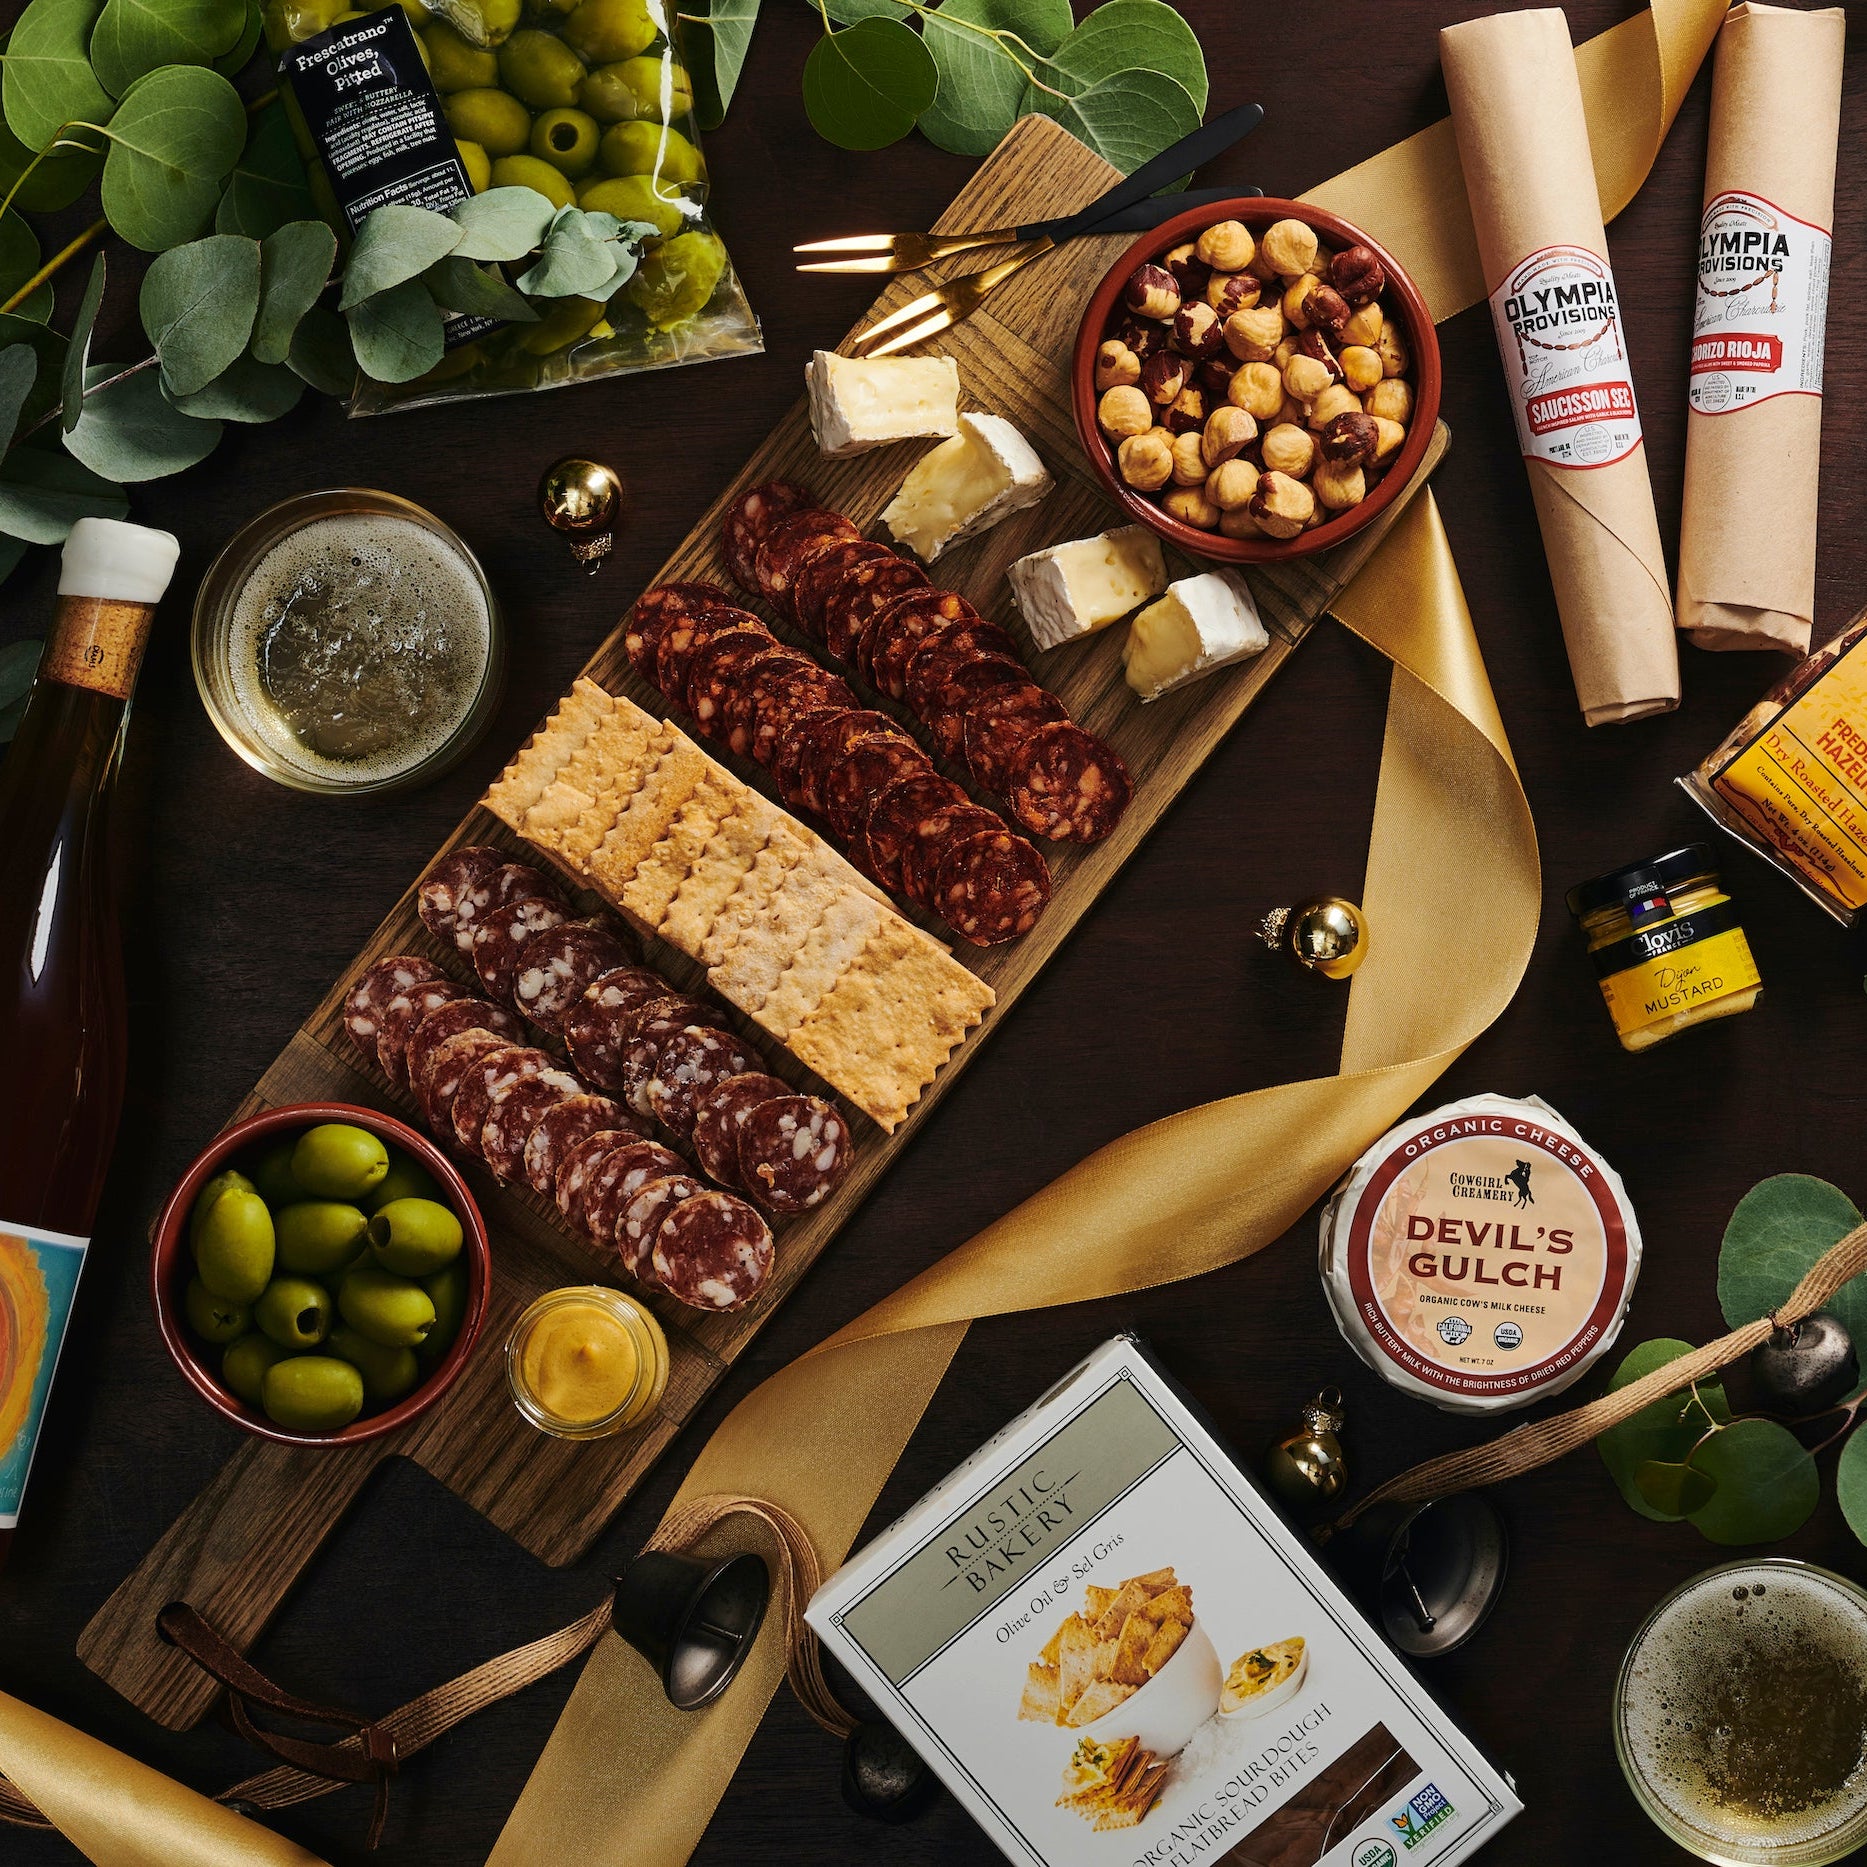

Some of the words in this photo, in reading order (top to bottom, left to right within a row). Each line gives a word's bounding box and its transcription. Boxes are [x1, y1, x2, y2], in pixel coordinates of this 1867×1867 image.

[327, 48, 379, 75] Olives,
[334, 60, 382, 91] Pitted
[343, 106, 363, 119] WITH
[365, 90, 413, 110] MOZZARELLA
[365, 86, 398, 101] BUTTERY
[325, 122, 361, 143] Ingredients:
[379, 109, 398, 119] water,
[410, 99, 426, 109] lactic
[362, 131, 377, 142] MAY
[377, 118, 408, 135] CONTAIN
[407, 111, 434, 124] PITS/PIT
[390, 111, 414, 123] ascorbic
[414, 106, 427, 115] acid
[332, 143, 371, 165] FRAGMENTS.
[370, 124, 414, 146] REFRIGERATE
[413, 119, 436, 130] AFTER
[336, 152, 366, 172] OPENING.
[365, 142, 393, 157] Produced
[403, 131, 424, 142] facility
[423, 127, 437, 135] that
[367, 155, 384, 166] eggs,
[382, 149, 396, 158] fish,
[395, 144, 411, 153] milk,
[409, 139, 423, 148] tree
[422, 135, 438, 144] nuts.
[349, 194, 385, 215] Nutrition
[384, 183, 408, 199] Facts
[430, 170, 446, 179] about
[422, 180, 444, 193] Amount
[444, 176, 454, 186] per
[423, 192, 440, 202] Total
[439, 188, 450, 197] Fat
[449, 185, 459, 194] 3g
[438, 193, 455, 204] Trans
[454, 190, 465, 199] Fat
[1700, 231, 1790, 259] LYMPIA
[1504, 281, 1615, 323] OLYMPIA
[1513, 305, 1616, 338] PROVISIONS
[1727, 340, 1771, 360] RIOJA
[1520, 362, 1581, 399] American
[1531, 389, 1611, 424] SAUCISSON
[1610, 387, 1631, 409] SEC
[1765, 732, 1790, 762] Dry
[1789, 758, 1844, 811] Roasted
[1757, 765, 1784, 795] Contains
[1783, 793, 1799, 813] Pure,
[1799, 810, 1813, 825] Dry
[1811, 823, 1838, 849] Roasted
[1835, 847, 1866, 879] Hazelnuts
[1761, 798, 1777, 815] Net
[1778, 812, 1790, 830] Wt.
[1791, 828, 1800, 836] 4
[1797, 835, 1809, 848] oz.
[1809, 846, 1837, 872] (114g)
[1628, 880, 1656, 894] PRODUCT
[1629, 892, 1636, 900] OF
[1635, 885, 1660, 898] FRANCE
[1652, 941, 1684, 957] FRANCE
[1654, 964, 1701, 991] Dijon
[1645, 976, 1724, 1016] MUSTARD
[1404, 1119, 1503, 1157] ORGANIC
[1514, 1124, 1594, 1179] CHEESE
[1452, 1185, 1515, 1202] CREAMERY
[1406, 1215, 1575, 1255] DEVIL’S
[1408, 1252, 1562, 1291] GULCH
[1419, 1294, 1459, 1306] ORGANIC
[1460, 1298, 1489, 1309] COW'S
[1490, 1301, 1512, 1311] MILK
[1513, 1304, 1547, 1315] CHEESE
[1437, 1322, 1472, 1335] CALIFORNIA
[1497, 1336, 1520, 1344] ORGANIC
[1500, 1328, 1517, 1336] USDA
[1364, 1302, 1379, 1323] RICH
[1374, 1322, 1404, 1354] BUTTERY
[1400, 1351, 1422, 1370] MILK
[1421, 1364, 1444, 1381] WITH
[1444, 1375, 1461, 1386] THE
[1462, 1378, 1517, 1390] BRIGHTNESS
[1518, 1374, 1532, 1385] OF
[1530, 1364, 1556, 1381] DRIED
[1555, 1353, 1572, 1369] RED
[1570, 1324, 1599, 1357] PEPPERS
[1459, 1356, 1470, 1364] NET
[945, 1470, 1056, 1568] RUSTIC
[965, 1493, 1074, 1593] BAKERY
[996, 1612, 1032, 1644] Olive
[1030, 1590, 1054, 1615] Oil
[1053, 1575, 1070, 1594] &
[1071, 1555, 1094, 1580] Sel
[1092, 1533, 1125, 1560] Gris
[1131, 1802, 1216, 1867] ORGANIC
[1213, 1702, 1333, 1808] SOURDOUGH
[1412, 1785, 1437, 1809] NON
[1169, 1784, 1269, 1867] FLATBREAD
[1268, 1740, 1320, 1788] BITES
[1418, 1792, 1441, 1815] GMO
[1423, 1799, 1448, 1820] Project
[1406, 1805, 1453, 1846] VERIFIED
[1358, 1845, 1383, 1867] USDA
